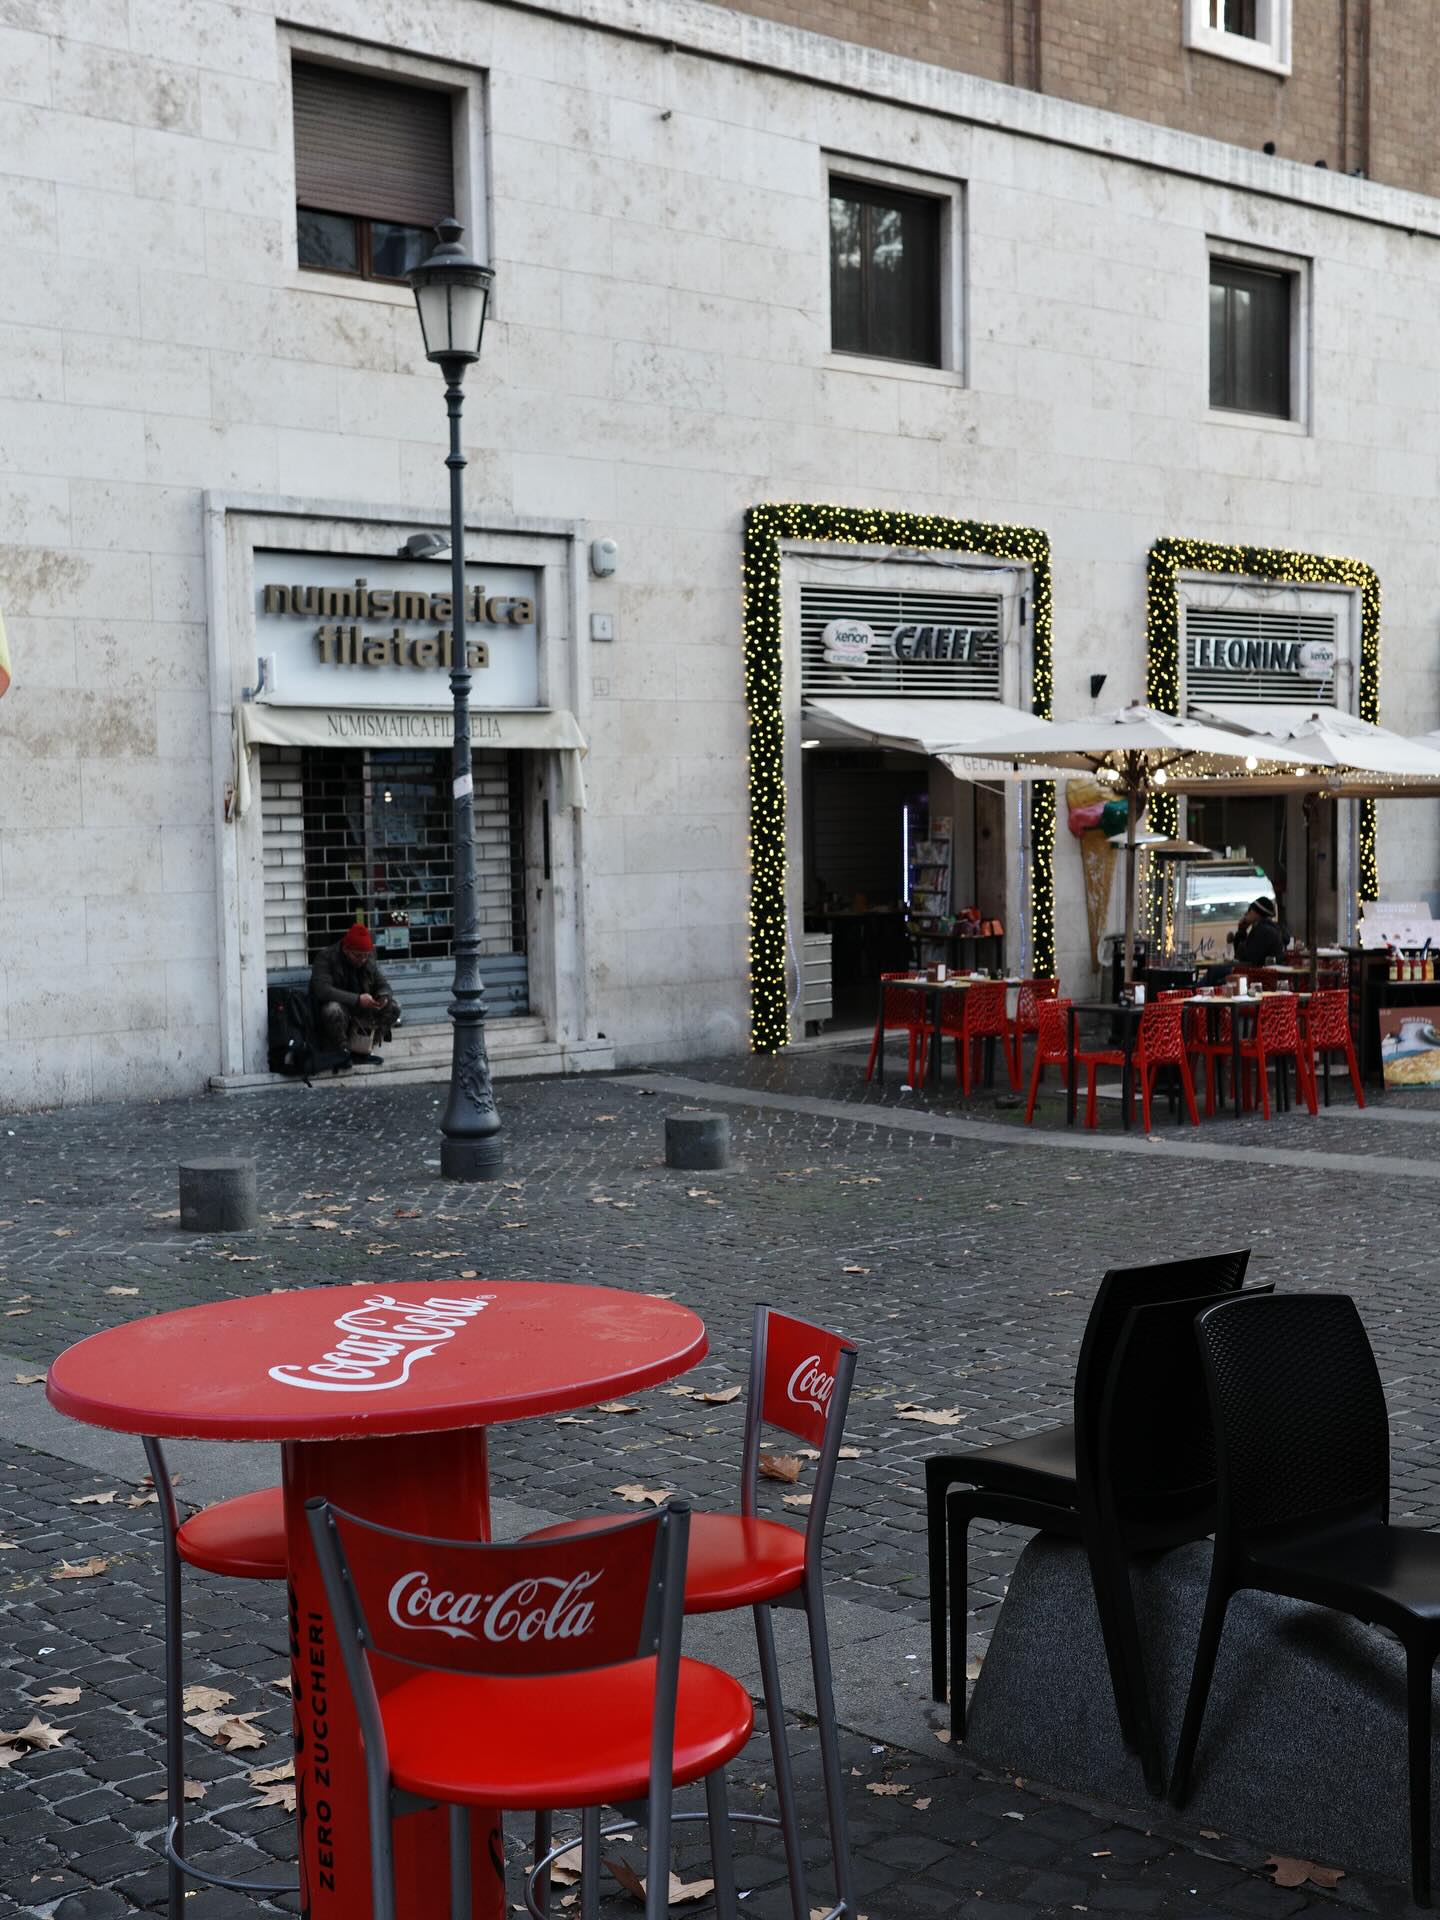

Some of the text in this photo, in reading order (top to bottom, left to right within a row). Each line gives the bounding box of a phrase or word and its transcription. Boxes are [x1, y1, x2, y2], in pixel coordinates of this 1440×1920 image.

[316, 624, 490, 669] filatela
[327, 714, 502, 739] NUMISMATICA FILELIA
[268, 1294, 489, 1392] Coca-Cola
[387, 1570, 604, 1642] Coca-Cola
[307, 1612, 335, 1892] ZERO ZUCCHERI
